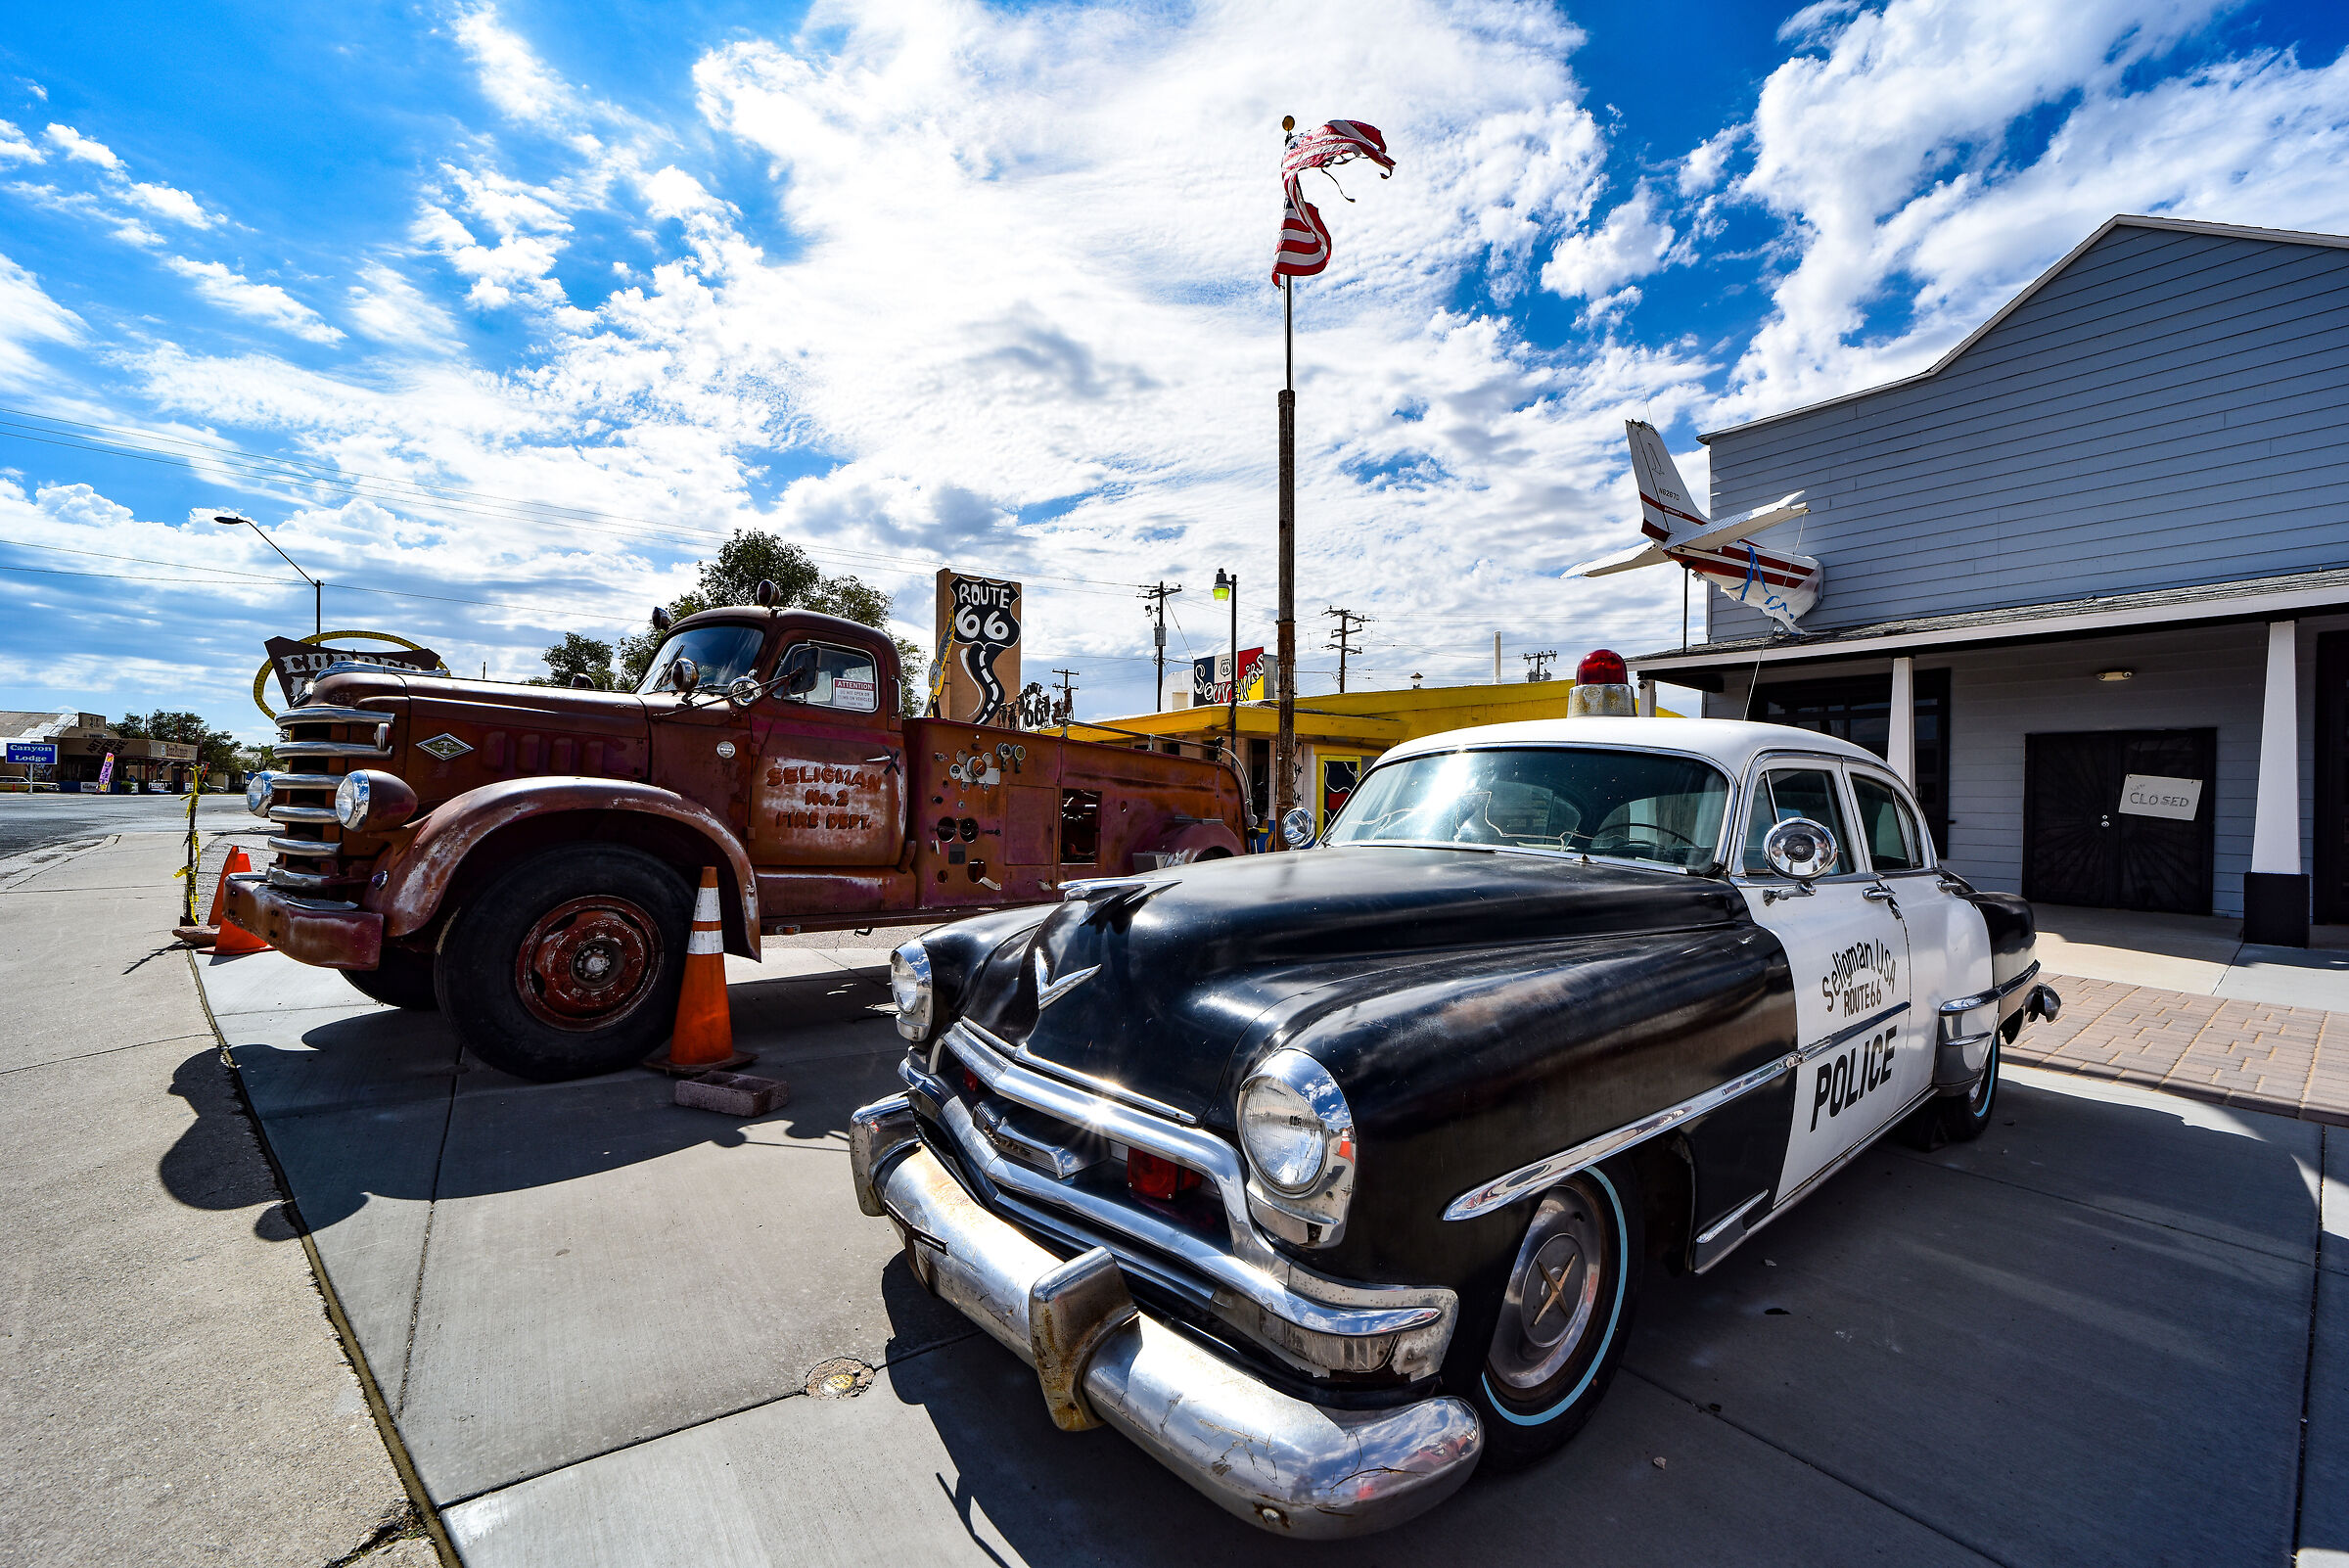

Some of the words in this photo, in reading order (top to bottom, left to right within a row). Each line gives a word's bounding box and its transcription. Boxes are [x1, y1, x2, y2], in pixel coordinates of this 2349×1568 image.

[958, 582, 1010, 610] ROUTE
[954, 604, 1009, 641] 66
[837, 680, 873, 690] ATTENTION
[1024, 698, 1044, 727] 66
[9, 744, 53, 753] Canyon
[766, 765, 882, 793] SELIGMAN
[2130, 792, 2189, 807] CLOSED
[775, 810, 820, 829] FIRE
[825, 812, 872, 830] DEPT.
[1875, 938, 1897, 995] USA
[1843, 983, 1870, 1018] ROUTE
[1870, 978, 1882, 1008] 66
[1809, 1024, 1898, 1133] POLICE
